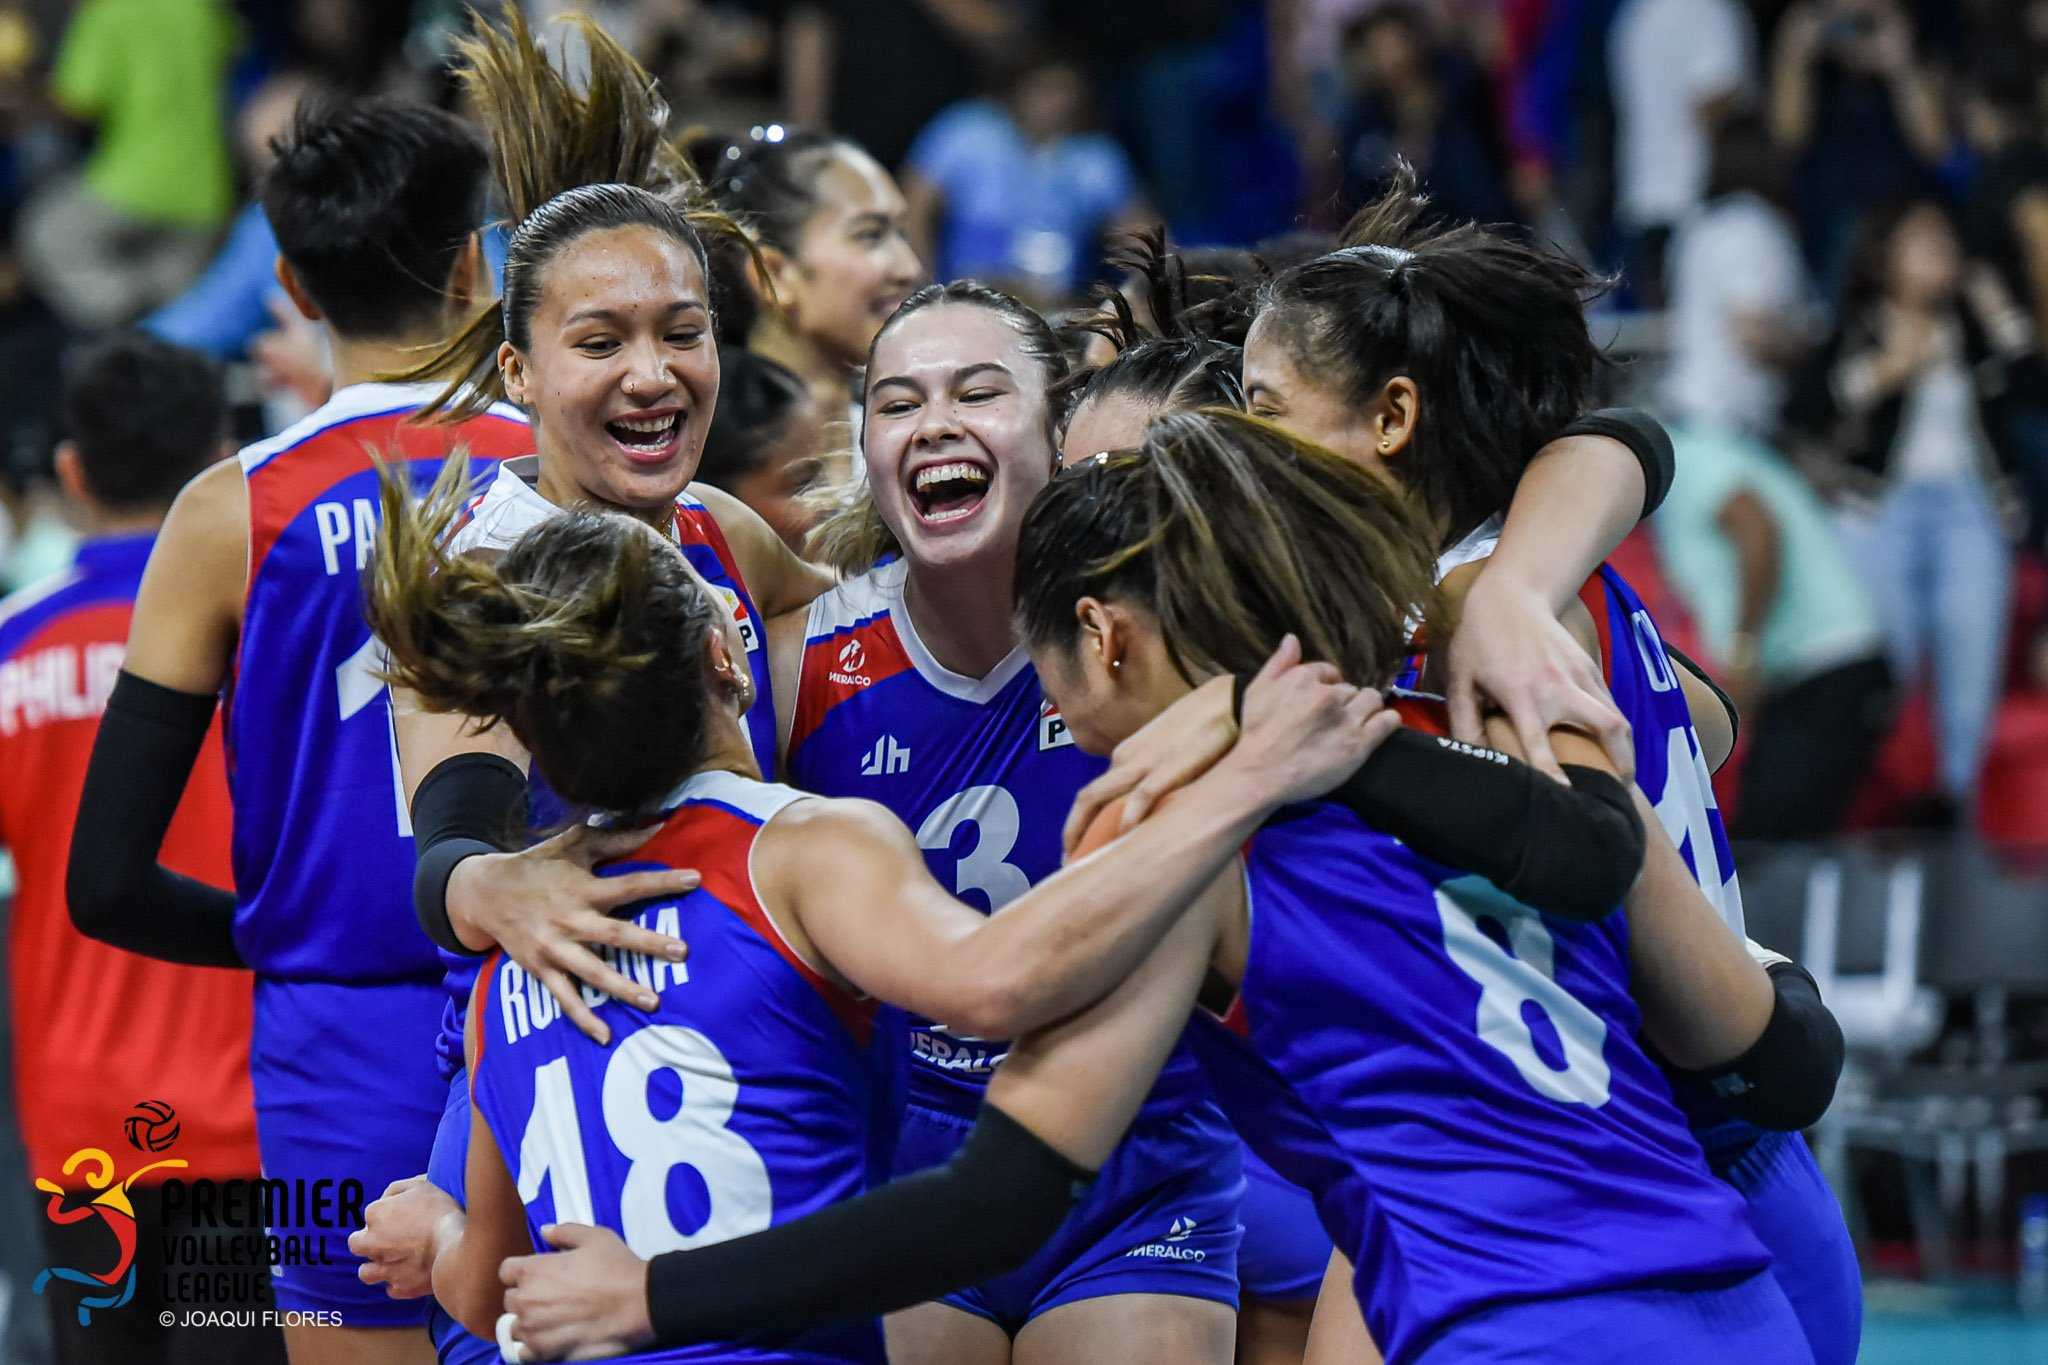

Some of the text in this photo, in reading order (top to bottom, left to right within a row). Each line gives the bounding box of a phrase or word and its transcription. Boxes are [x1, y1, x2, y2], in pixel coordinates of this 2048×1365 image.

[915, 784, 1031, 914] 3
[1434, 873, 1611, 1110] 8
[517, 1023, 773, 1261] 18
